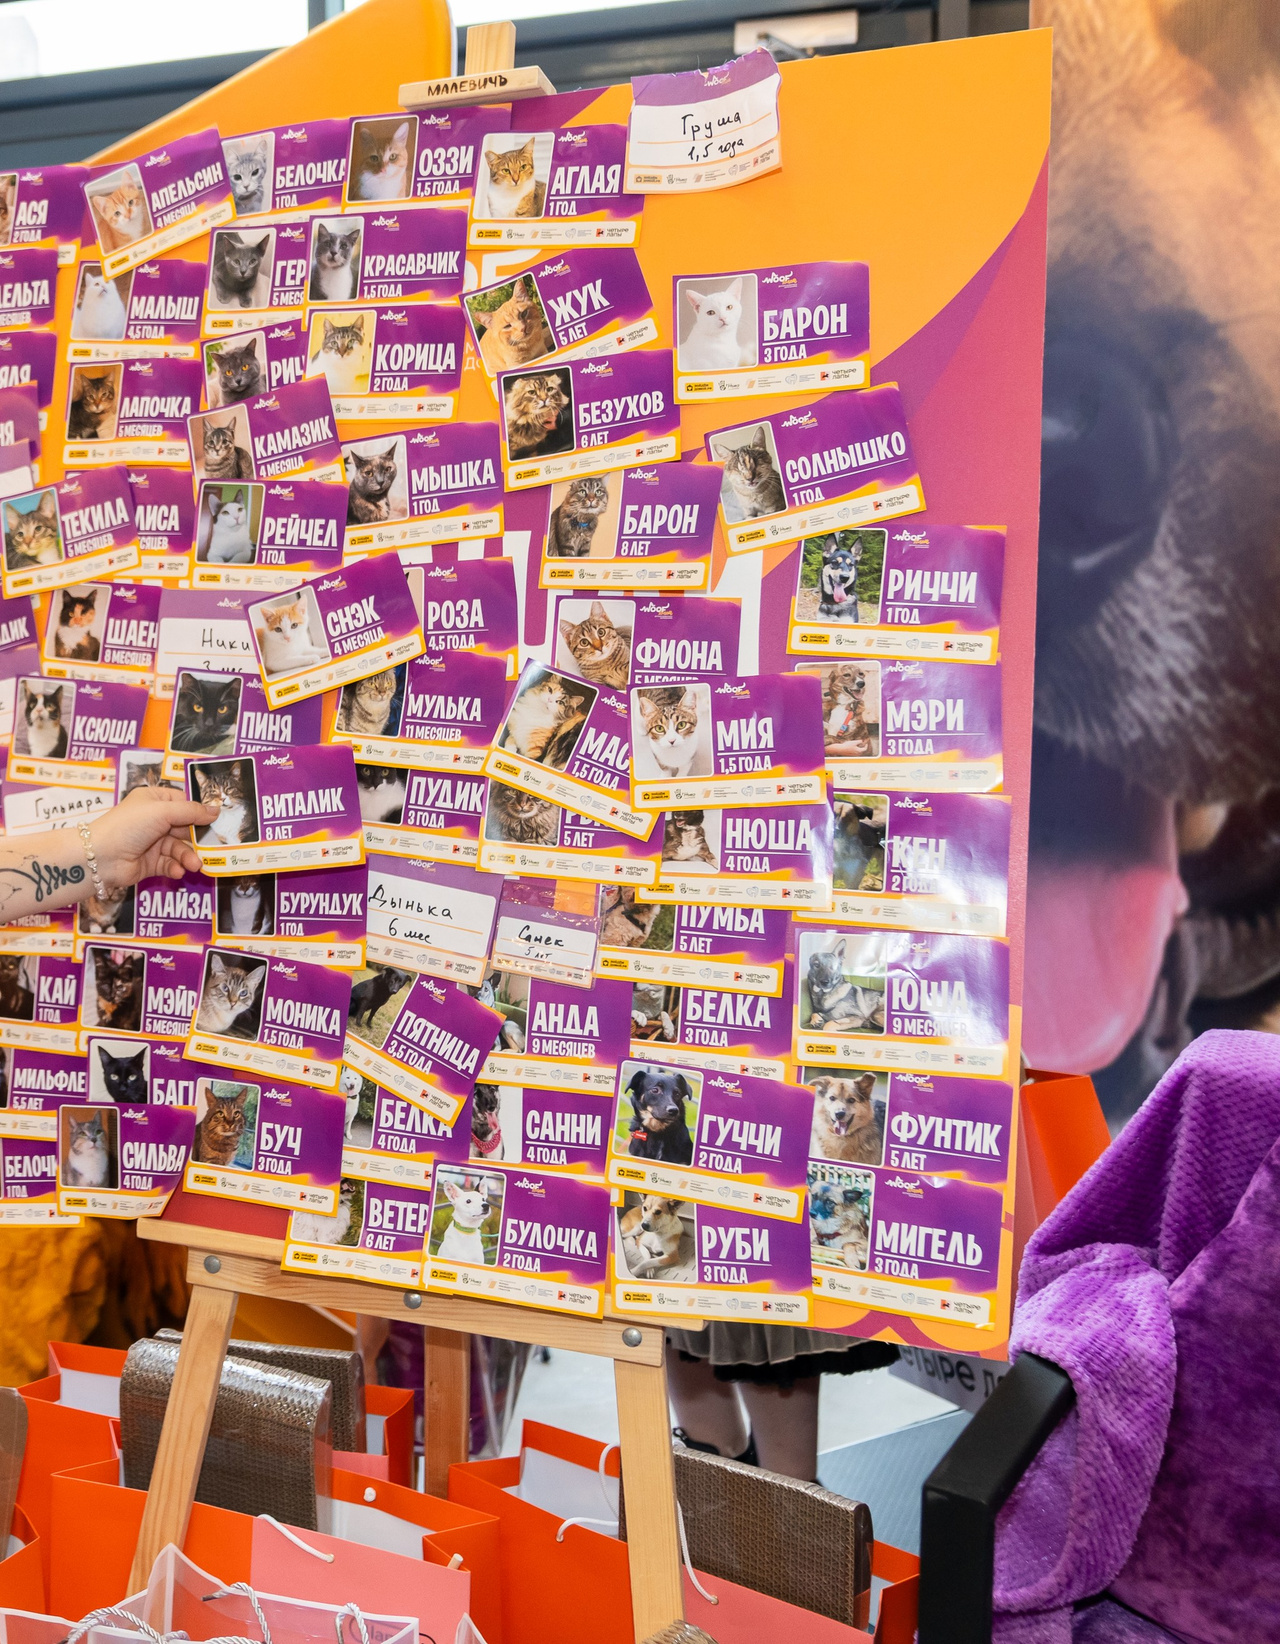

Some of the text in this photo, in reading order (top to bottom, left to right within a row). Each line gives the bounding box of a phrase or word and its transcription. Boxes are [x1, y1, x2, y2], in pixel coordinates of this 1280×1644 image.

[276, 158, 346, 189] БЕЛОЧКА
[419, 146, 474, 177] ОЗЗИ
[151, 162, 224, 213] АПЕЛЬСИН
[430, 180, 460, 195] ГОДА
[551, 165, 621, 195] АГЛАЯ
[16, 200, 48, 226] АСЯ
[558, 199, 577, 216] ГОД
[364, 251, 460, 277] КРАСАВЧИК
[376, 284, 402, 298] ГОДА
[548, 279, 610, 327] ЖУК
[130, 296, 199, 320] МАЛЫШ
[763, 303, 847, 341] БАРОН
[568, 323, 589, 342] ЛЕТ
[374, 343, 456, 372] КОРИЦА
[764, 344, 807, 363] 3 ГОДА
[382, 377, 408, 391] ГОДА
[120, 397, 191, 418] ЛАПОЧКА
[579, 391, 665, 426] БЕЗУХОВ
[254, 416, 333, 458] КАМАЗИК
[589, 431, 609, 447] ЛЕТ
[785, 431, 906, 483] СОЛНЫШКО
[411, 458, 496, 493] МЫШКА
[800, 487, 825, 505] ГОД
[62, 497, 129, 540] ТЕКИЛА
[263, 514, 337, 547] РЕЙЧЕЛ
[624, 504, 699, 534] БАРОН
[631, 541, 650, 555] ЛЕТ
[887, 569, 977, 603] РИЧЧИ
[326, 595, 381, 637] СНЭК
[428, 599, 484, 630] РОЗА
[894, 608, 920, 624] ГОД
[342, 629, 385, 652] МЕСЯЦА
[447, 634, 475, 649] ГОДА
[636, 638, 723, 670] ФИОНА
[407, 694, 482, 721] МУЛЬКА
[887, 699, 964, 731] МЭРИ
[74, 716, 138, 745] КСЮША
[242, 712, 292, 742] ПИНЯ
[414, 726, 462, 742] МЕСЯЦЕВ
[717, 718, 774, 751] МИЯ
[887, 739, 934, 755] 3 ГОДА
[738, 755, 772, 772] ГОДА
[262, 787, 345, 819] ВИТАЛИК
[408, 776, 484, 812] ПУДИК
[274, 825, 292, 839] ЛЕТ
[416, 814, 444, 829] ГОДА
[726, 818, 812, 850] НЮША
[737, 856, 770, 872] ГОДА
[892, 835, 946, 870] КЕН
[139, 888, 212, 920] ЭЛАЙЗА
[280, 892, 363, 916] БУРУНДУК
[389, 918, 398, 937] 6
[689, 937, 713, 953] ЛЕТ
[38, 975, 77, 1006] КАЙ
[891, 978, 968, 1012] ЮША
[266, 996, 341, 1036] МОНИКА
[532, 1002, 599, 1037] АНДА
[686, 989, 771, 1028] БЕЛКА
[396, 1009, 481, 1074] ПЯТНИЦА
[542, 1040, 595, 1058] МЕСЯЦЕВ
[695, 1028, 728, 1047] ГОДА
[260, 1122, 302, 1156] БУЧ
[526, 1110, 601, 1146] САННИ
[700, 1114, 782, 1157] ГУЧЧИ
[890, 1111, 1002, 1156] ФУНТИК
[122, 1142, 186, 1172] СИЛЬВА
[537, 1149, 567, 1165] ГОДА
[708, 1152, 742, 1174] ГОДА
[900, 1153, 927, 1171] ЛЕТ
[368, 1197, 429, 1234] ВЕТЕР
[505, 1218, 598, 1258] БУЛОЧКА
[701, 1226, 770, 1262] РУБИ
[875, 1220, 982, 1266] МИГЕЛЬ
[513, 1254, 541, 1273] ГОДА
[714, 1266, 748, 1284] ГОДА
[885, 1260, 919, 1280] ГОДА
